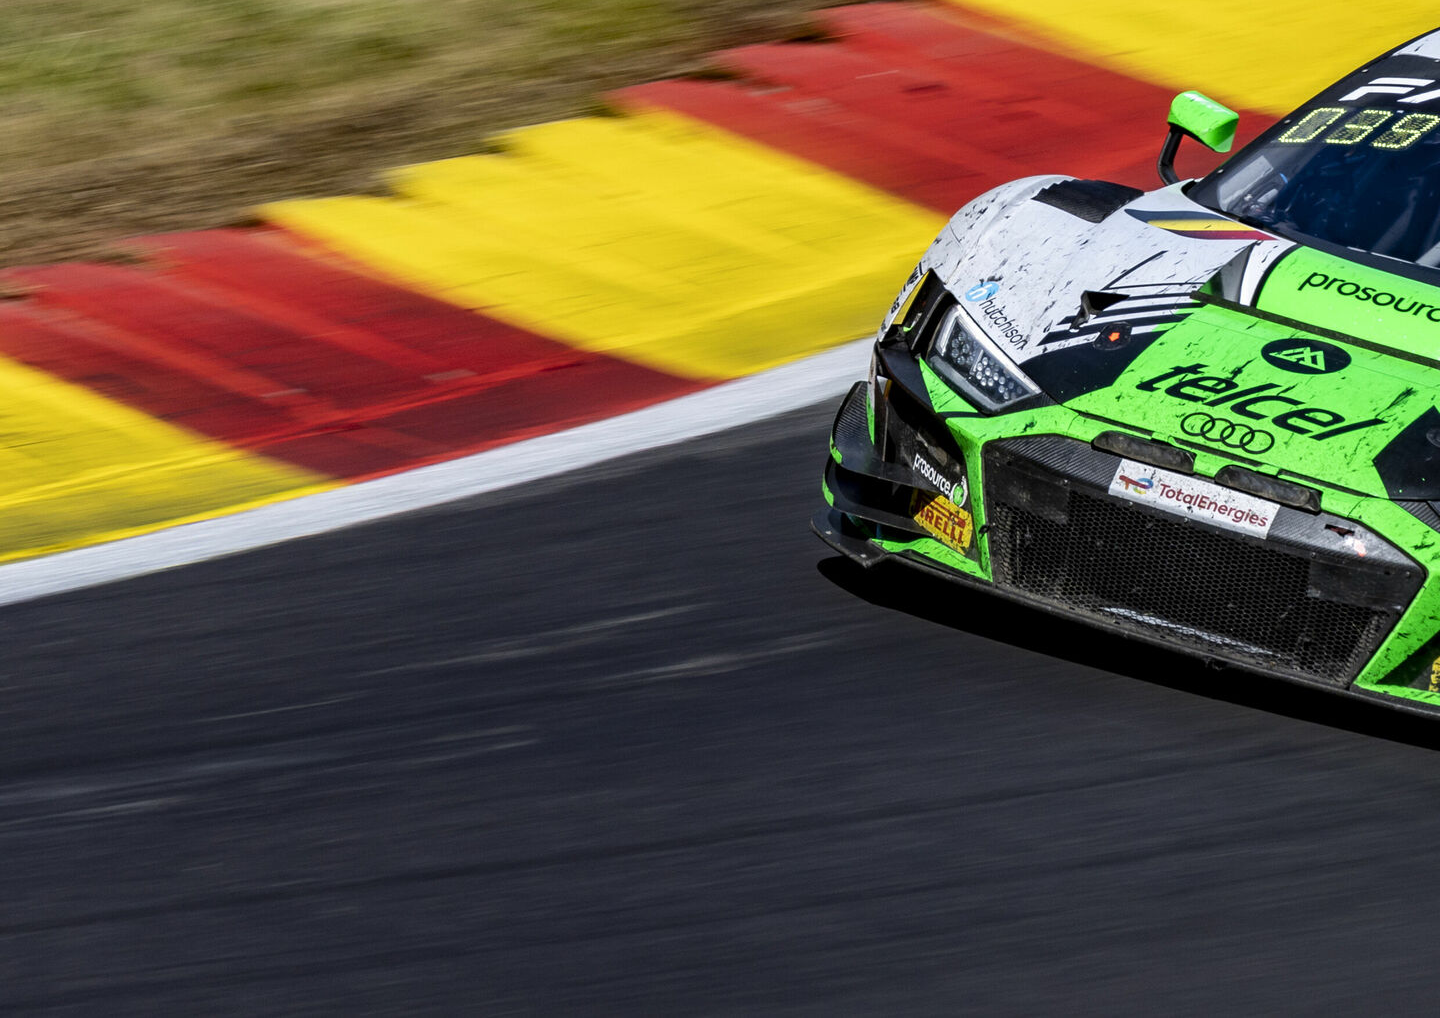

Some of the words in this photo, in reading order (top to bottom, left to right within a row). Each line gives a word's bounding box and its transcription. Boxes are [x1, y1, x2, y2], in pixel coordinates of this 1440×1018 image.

[979, 297, 1028, 351] hutchison
[1135, 362, 1389, 441] telcel
[1160, 483, 1269, 527] TotalEnergies
